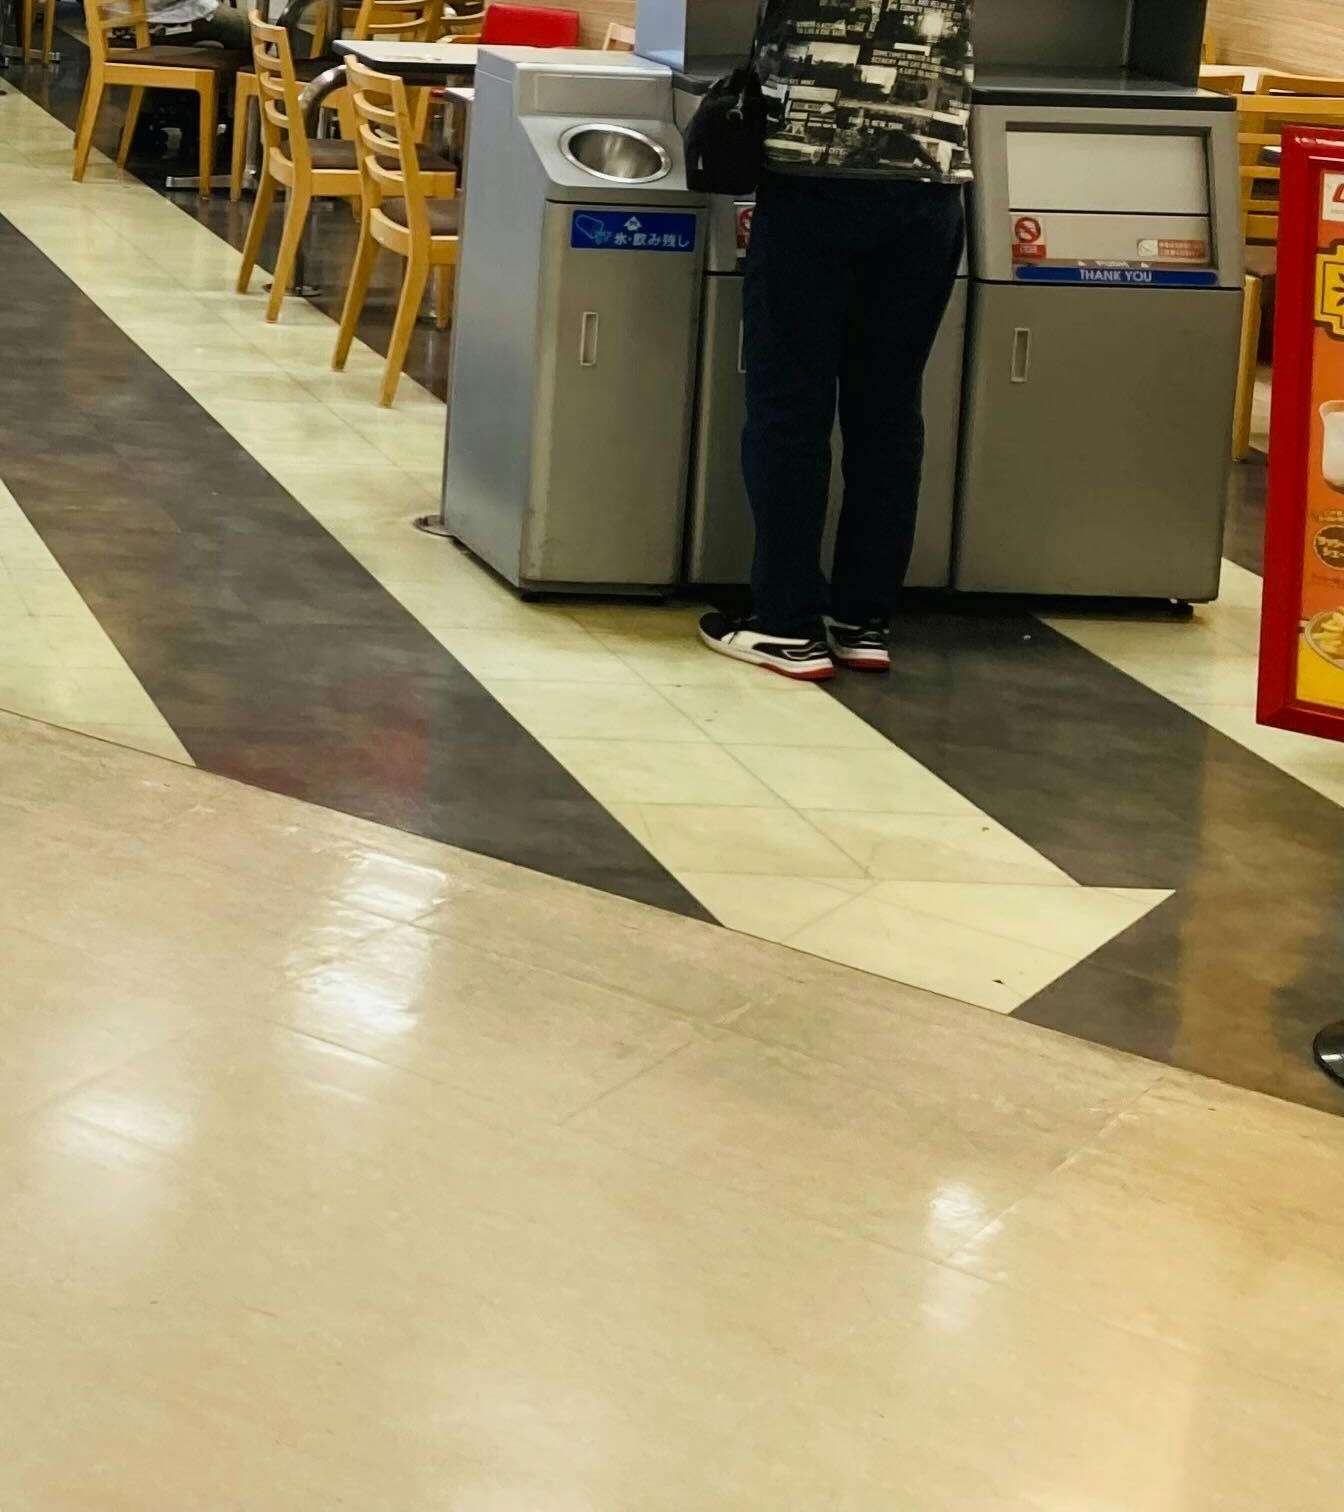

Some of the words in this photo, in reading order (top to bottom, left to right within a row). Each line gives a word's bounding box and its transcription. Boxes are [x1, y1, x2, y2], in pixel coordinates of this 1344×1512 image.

[614, 232, 690, 248] 氷・飲み残し
[1080, 269, 1122, 281] THANK
[1125, 270, 1153, 283] YOU
